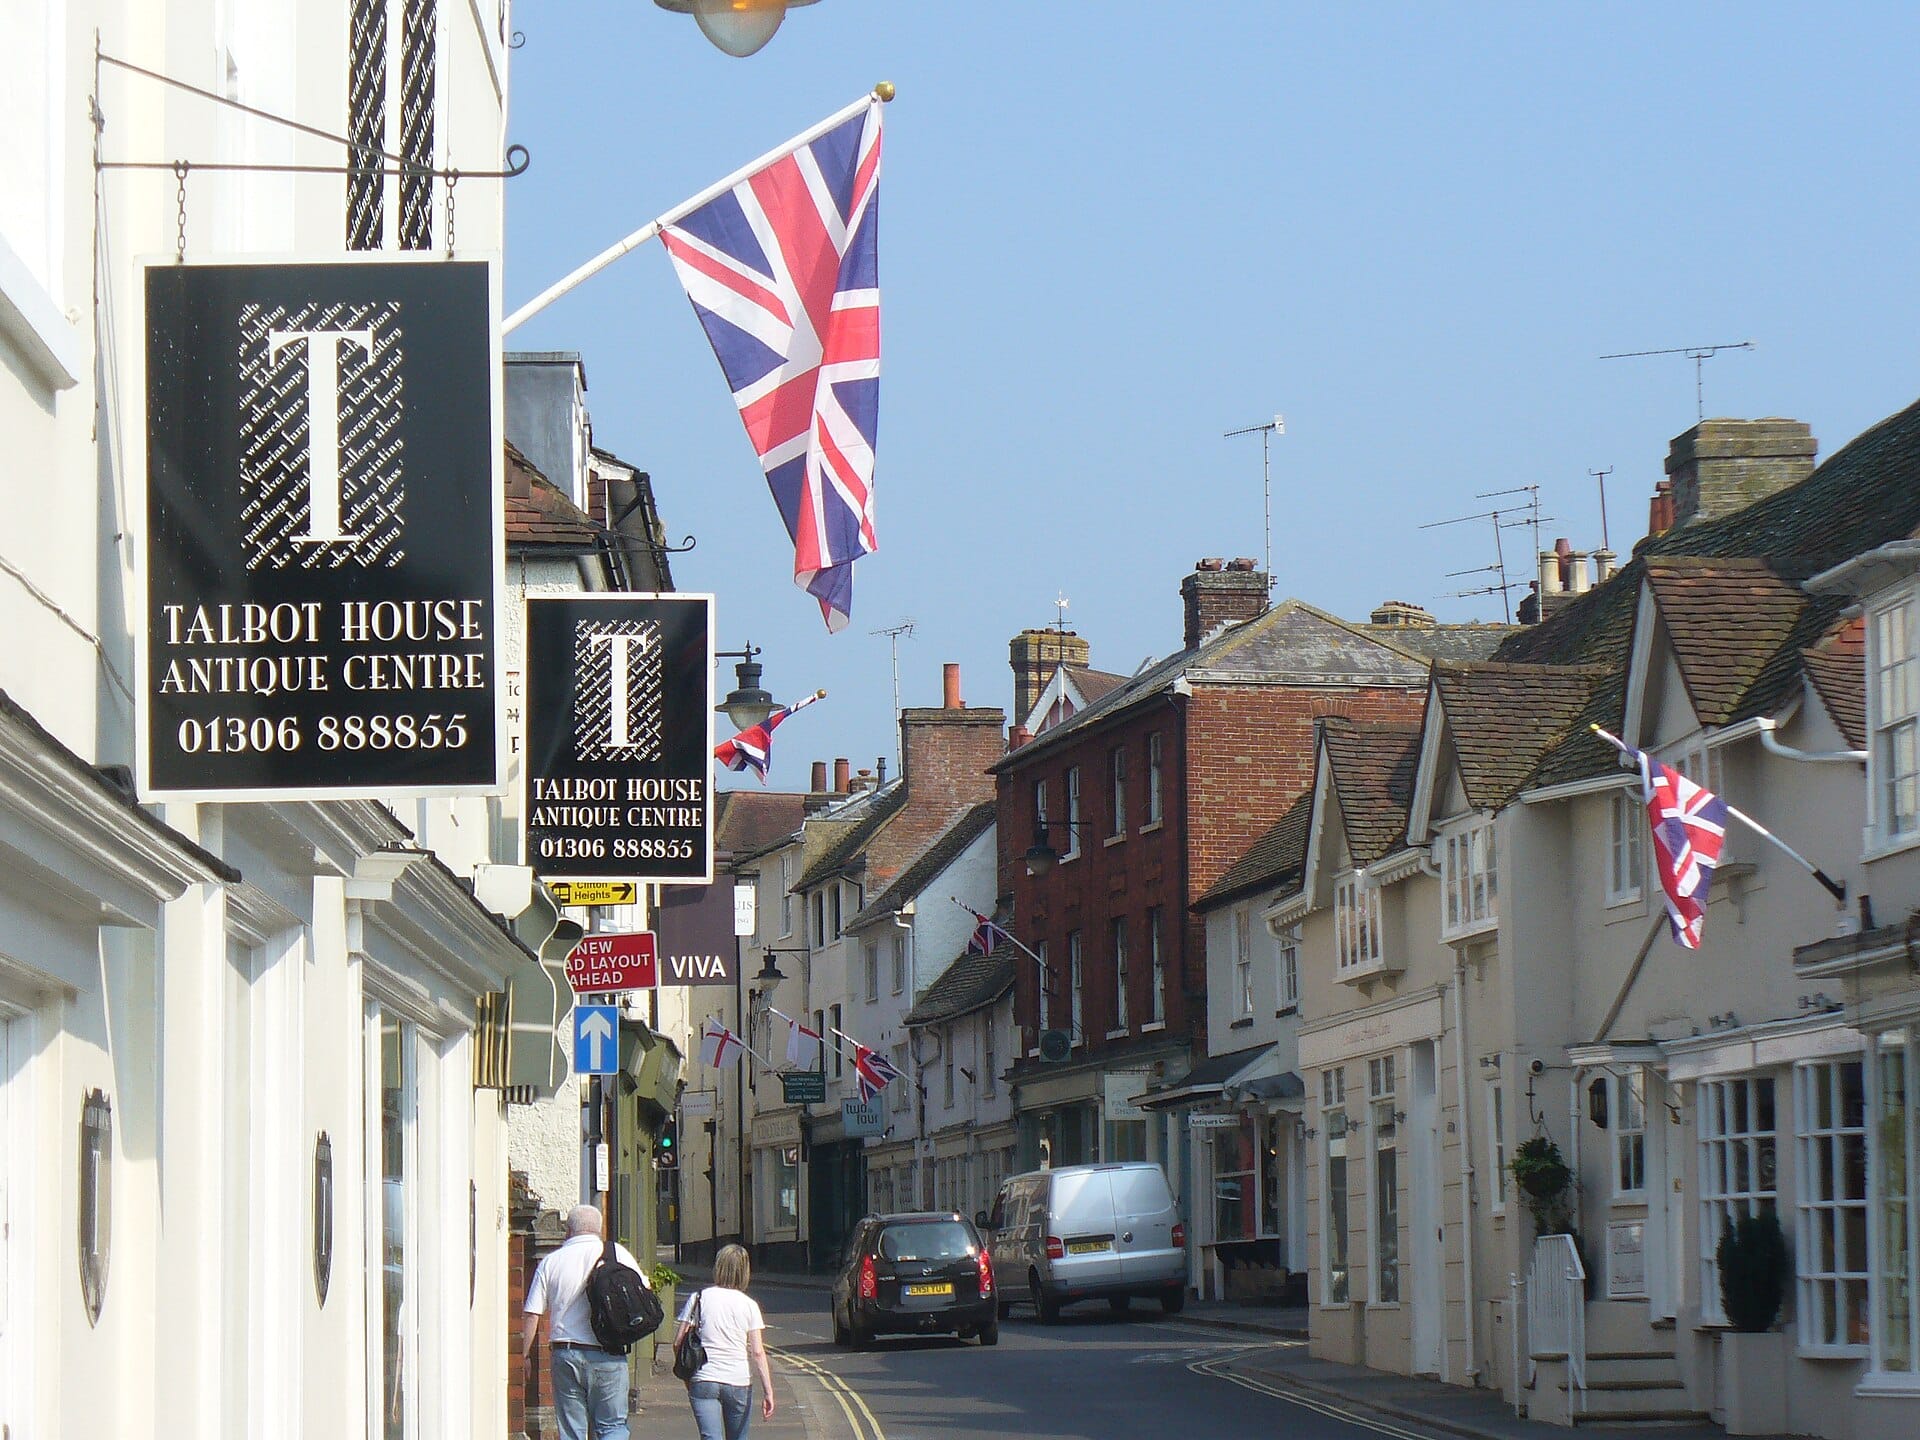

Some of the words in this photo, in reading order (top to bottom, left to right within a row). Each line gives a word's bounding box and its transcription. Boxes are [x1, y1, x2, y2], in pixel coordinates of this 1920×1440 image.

[252, 339, 307, 389] Edwardian
[252, 396, 277, 424] silver
[271, 368, 304, 398] lamps
[247, 398, 304, 456] watercolours
[260, 472, 286, 500] silver
[346, 376, 381, 406] books
[375, 411, 401, 440] silver
[240, 443, 287, 484] Victorian
[342, 479, 358, 501] oil
[343, 492, 379, 528] pottery
[377, 467, 402, 494] glass
[244, 498, 288, 544] paintings
[374, 505, 389, 526] oil
[353, 526, 401, 569] lighting
[164, 602, 322, 644] TALBOT
[341, 599, 484, 643] HOUSE
[159, 656, 330, 696] ANTIQUE
[343, 653, 484, 691] CENTRE
[178, 716, 300, 754] 01306
[317, 713, 468, 751] 888855
[532, 778, 617, 801] TALBOT
[626, 778, 702, 802] HOUSE
[531, 807, 621, 830] ANTIQUE
[627, 805, 702, 827] CENTRE
[540, 838, 606, 860] 01306
[612, 838, 693, 858] 888855
[574, 891, 610, 901] Heights
[576, 941, 613, 955] NEW
[590, 954, 650, 970] LAYOUT
[570, 971, 623, 986] AHEAD
[670, 955, 727, 979] VIVA
